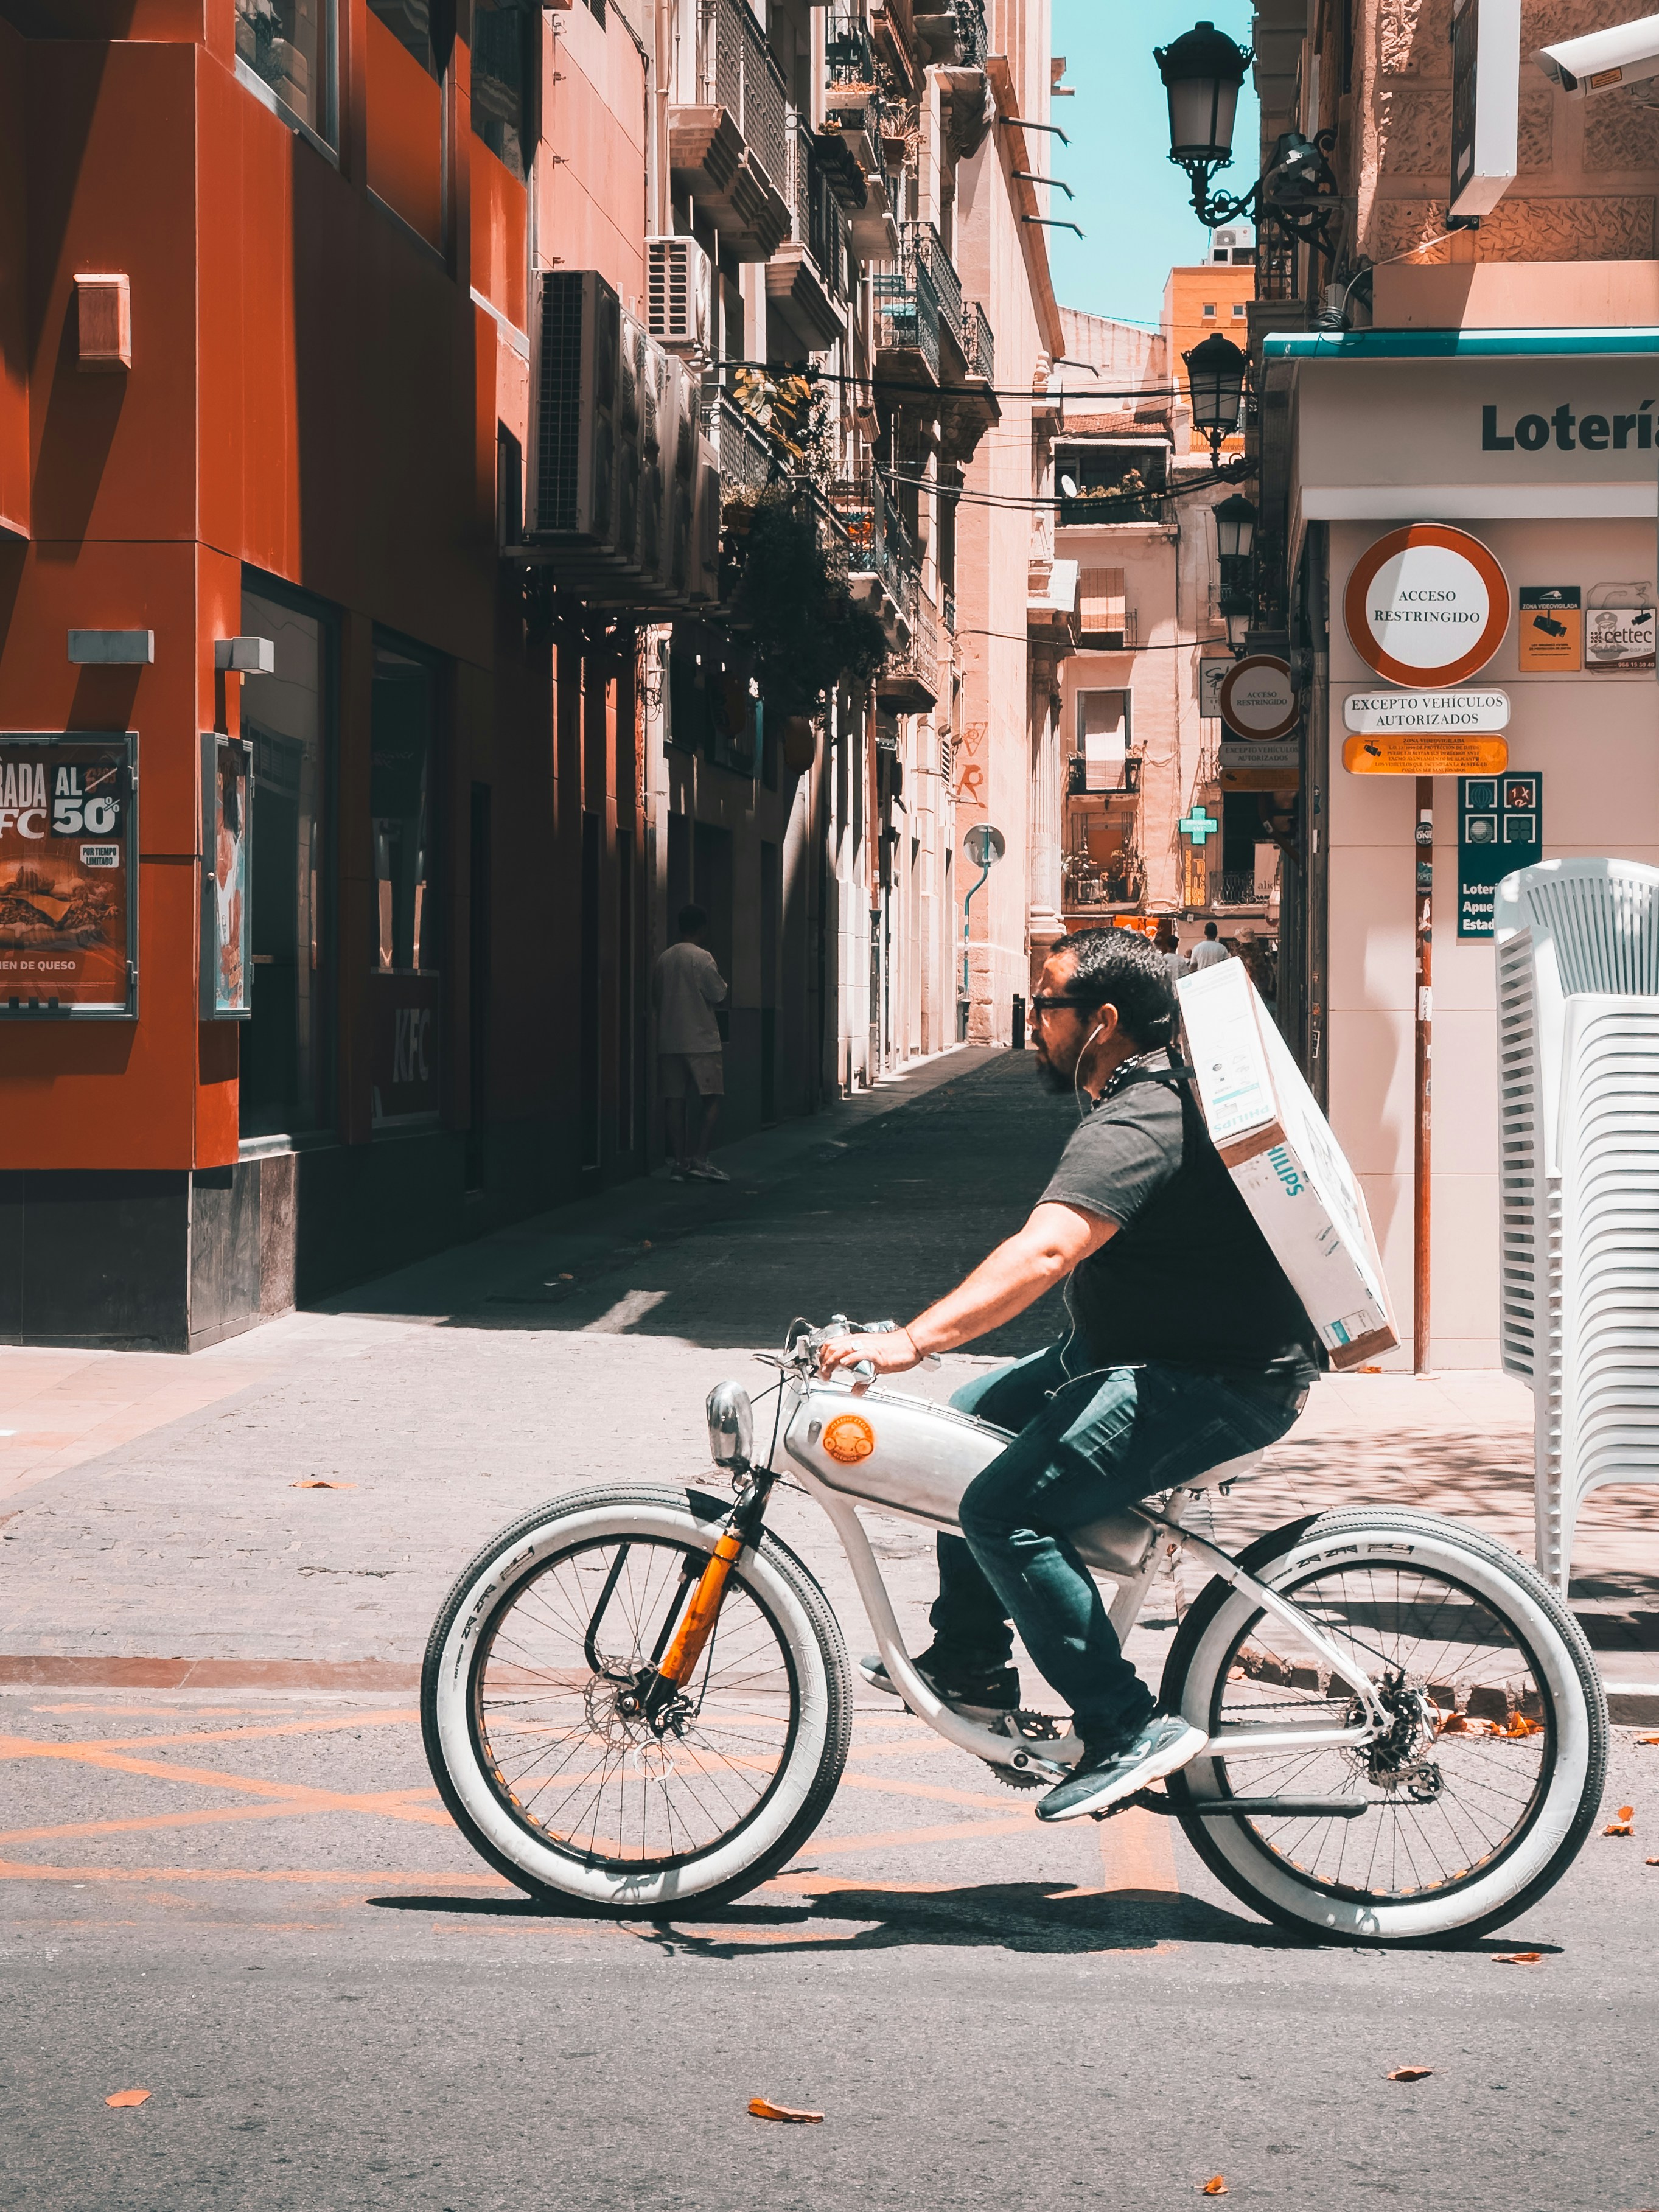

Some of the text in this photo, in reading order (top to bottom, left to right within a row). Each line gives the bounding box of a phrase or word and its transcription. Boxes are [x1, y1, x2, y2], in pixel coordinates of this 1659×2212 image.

[1482, 399, 1659, 451] Loterí
[1398, 590, 1456, 601] ACCESO
[1374, 610, 1480, 624] RESTRINGIDO
[1604, 628, 1652, 644] cettec
[1351, 694, 1503, 711] EXCEPTO VEHÍCULOS
[1377, 712, 1479, 726] AUTORIZADOS
[0, 763, 47, 808] ADA
[55, 767, 82, 795] AL
[52, 797, 120, 834] 50%
[83, 847, 117, 856] POR TIEMPO
[86, 857, 113, 865] LIMITADO
[1463, 918, 1495, 930] Estad
[0, 961, 76, 971] EN DE QUESO
[393, 1008, 431, 1083] KFC
[1212, 1104, 1270, 1133] PHILIPS
[1296, 1544, 1358, 1568] ZIG ZAG
[461, 1583, 497, 1640] ZIG ZAG
